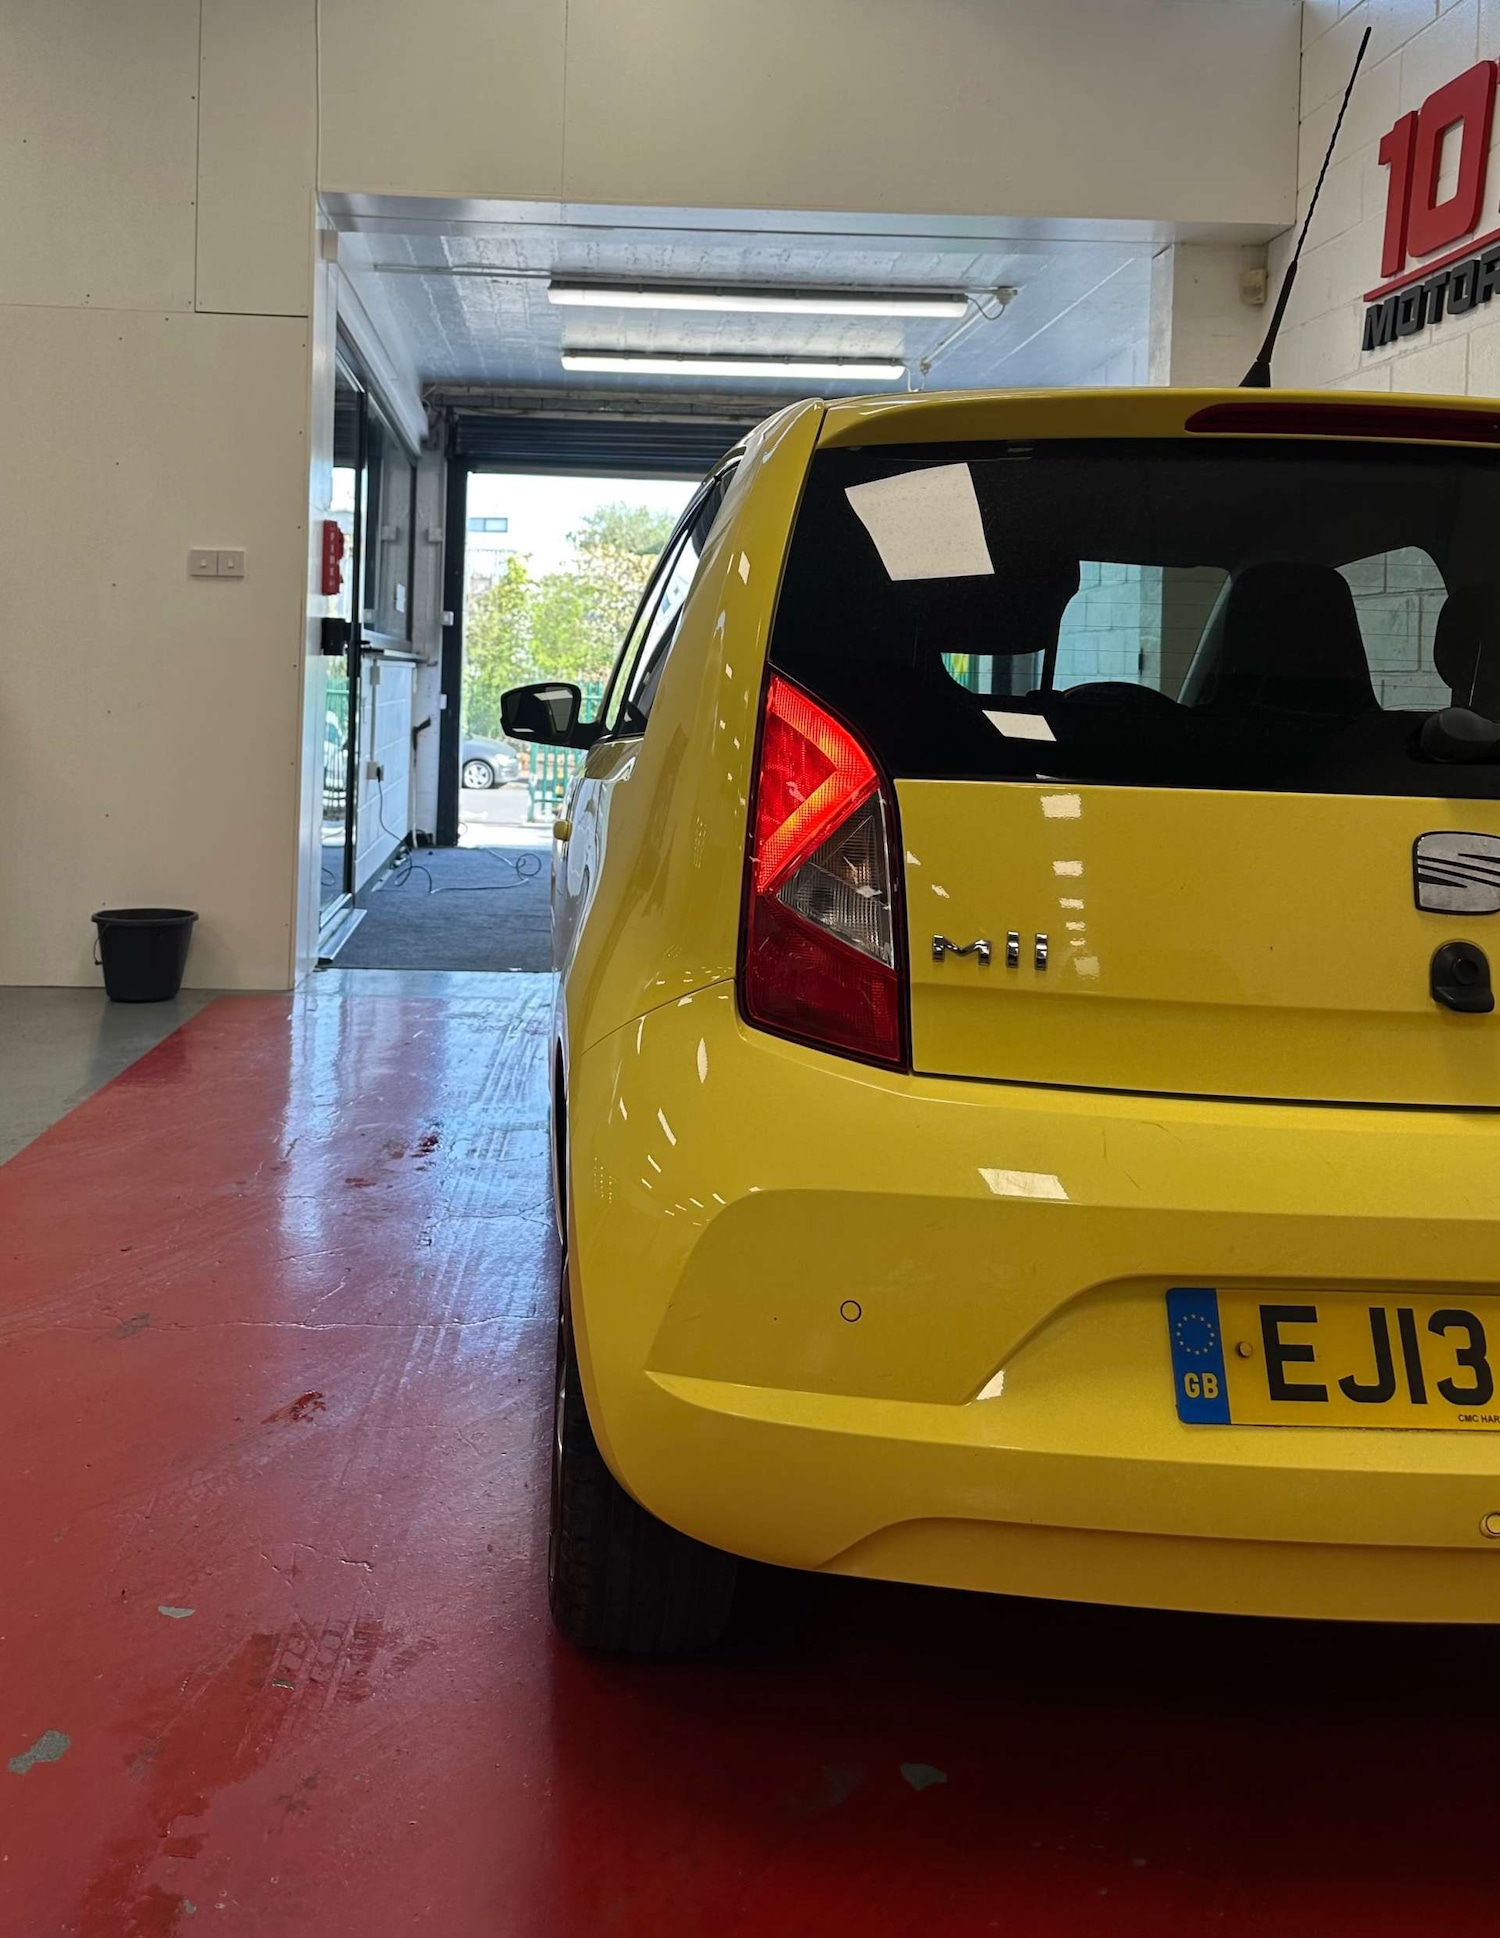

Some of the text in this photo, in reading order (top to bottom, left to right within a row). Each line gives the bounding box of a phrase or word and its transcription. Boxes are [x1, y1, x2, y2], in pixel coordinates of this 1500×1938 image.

[1378, 58, 1500, 279] 10
[1184, 1372, 1219, 1399] GB
[1458, 1413, 1479, 1423] CMC
